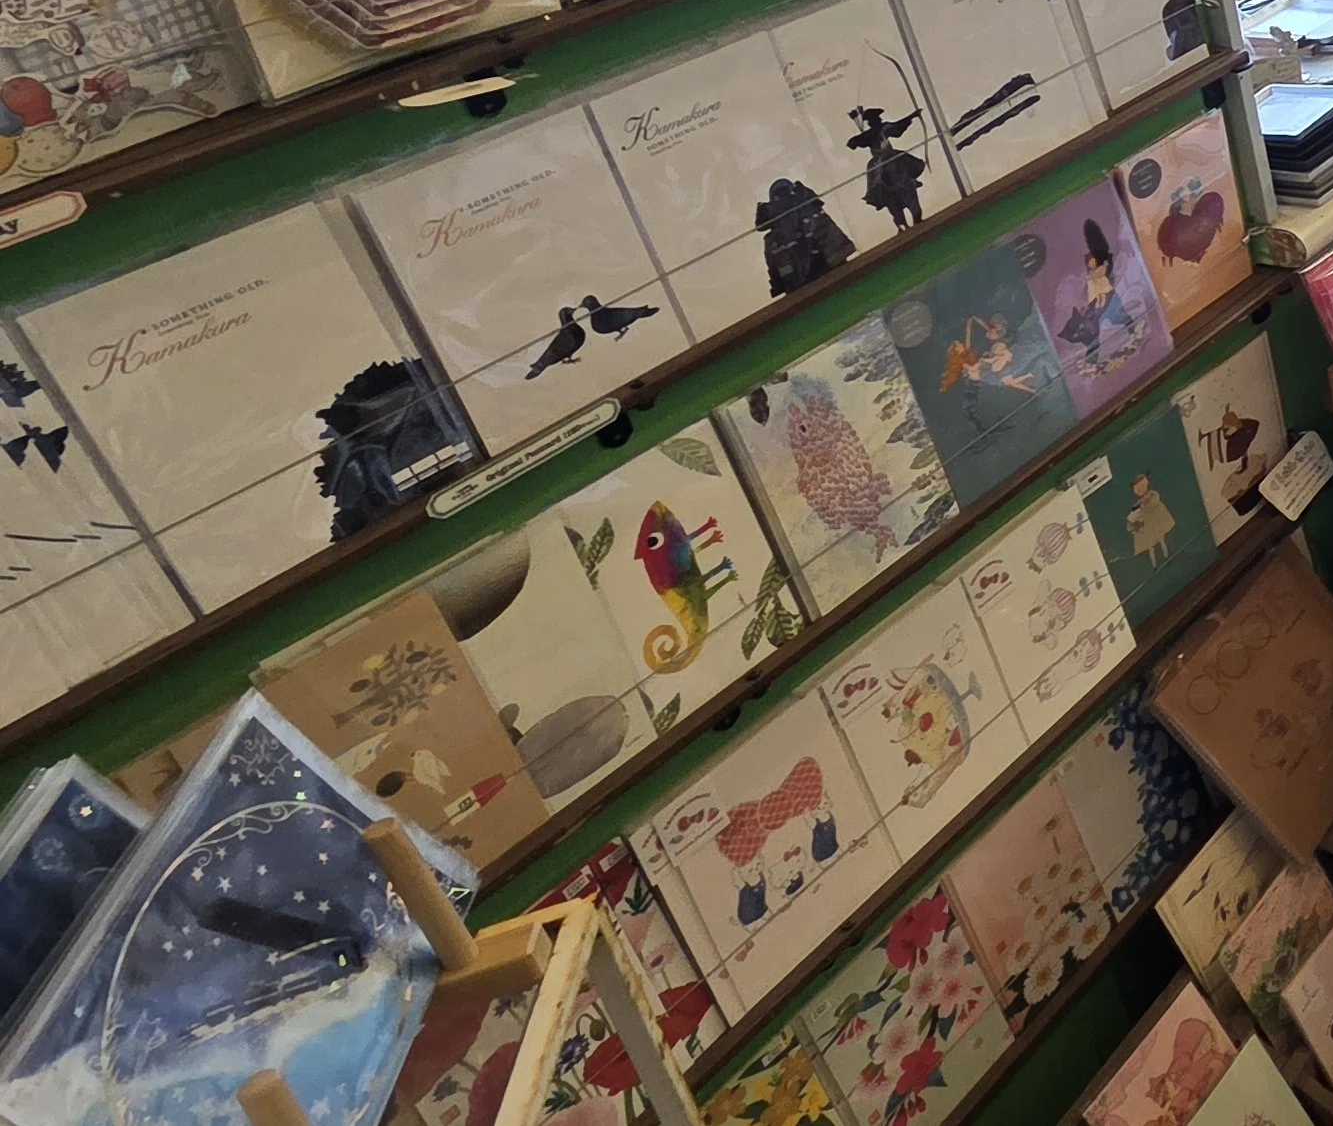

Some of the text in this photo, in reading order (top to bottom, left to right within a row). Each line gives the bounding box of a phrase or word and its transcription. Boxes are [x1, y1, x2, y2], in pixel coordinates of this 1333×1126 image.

[621, 99, 722, 151] Kamakura
[465, 169, 557, 211] SOMETHING OLD.
[416, 196, 544, 260] Kamakura
[151, 277, 271, 332] SOMETHING OLD.
[82, 311, 252, 392] Kamakura
